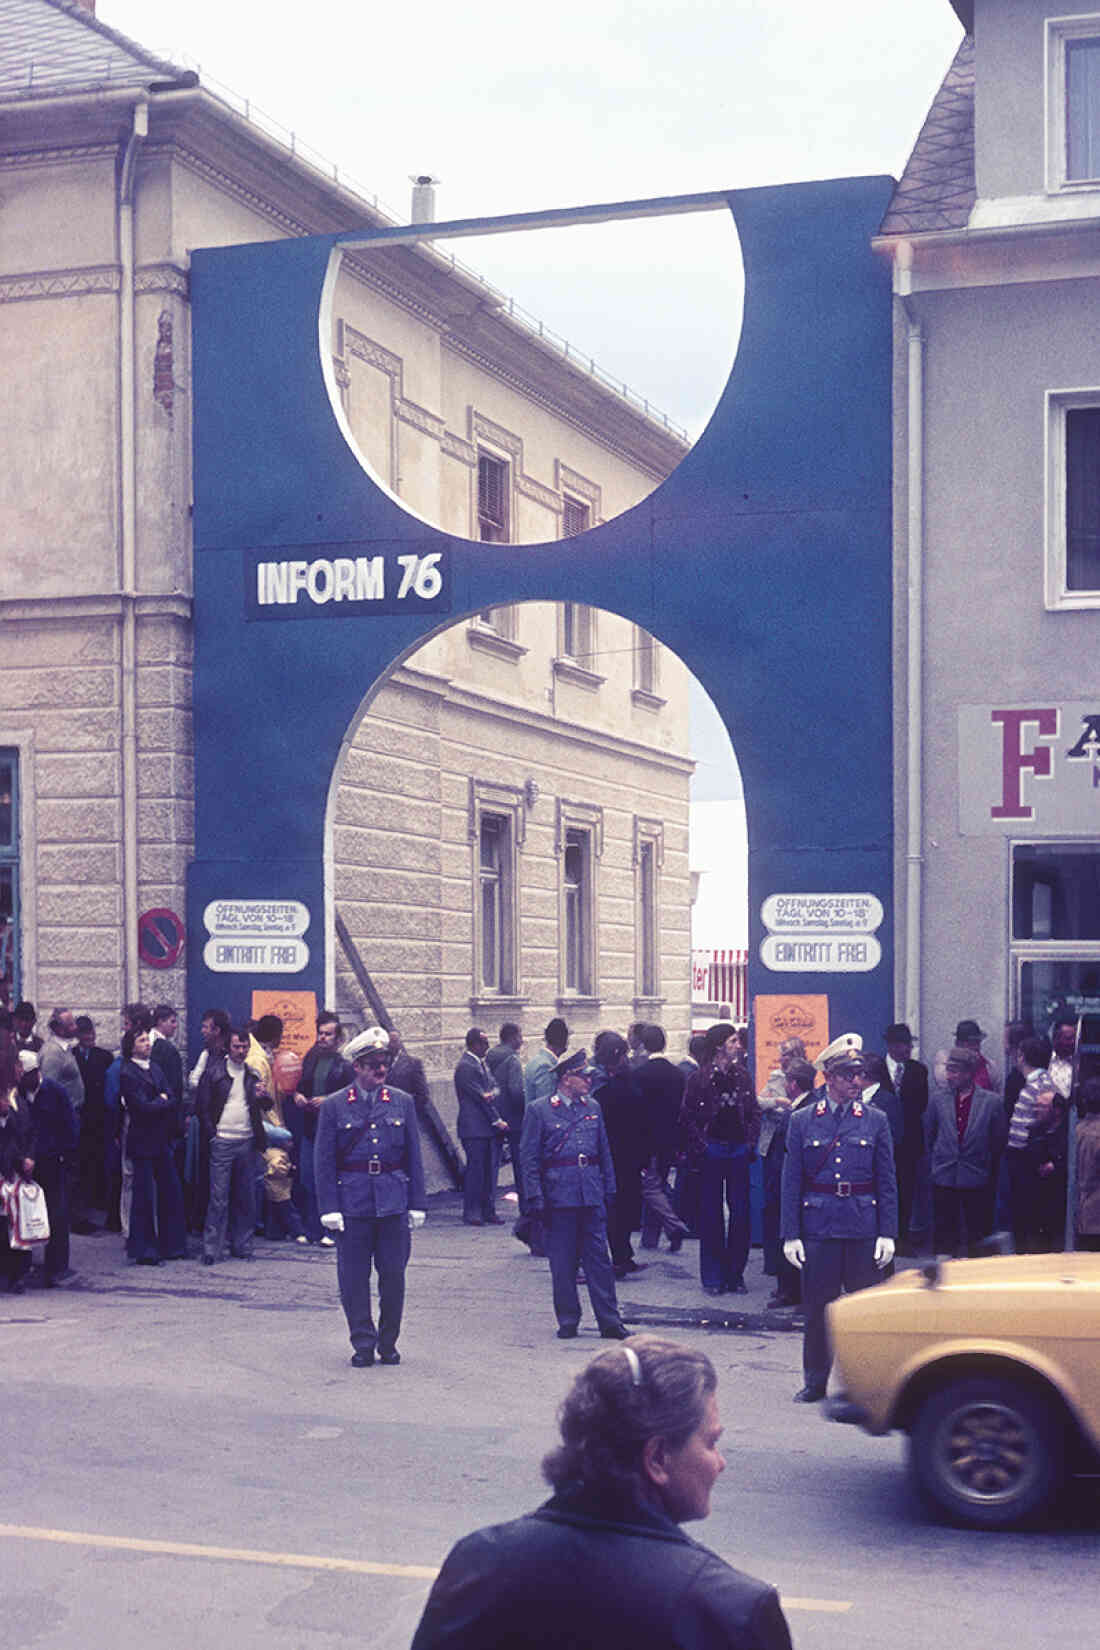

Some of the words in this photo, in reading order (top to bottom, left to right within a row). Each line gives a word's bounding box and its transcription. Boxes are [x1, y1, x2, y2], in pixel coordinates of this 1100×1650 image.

[257, 556, 385, 605] INFORM
[397, 552, 443, 600] 76
[243, 914, 264, 923] VON
[806, 908, 831, 918] VON
[216, 945, 265, 964] EINTRITT
[271, 945, 297, 964] FREI
[776, 943, 832, 962] EINTRITT
[838, 943, 867, 962] FREI
